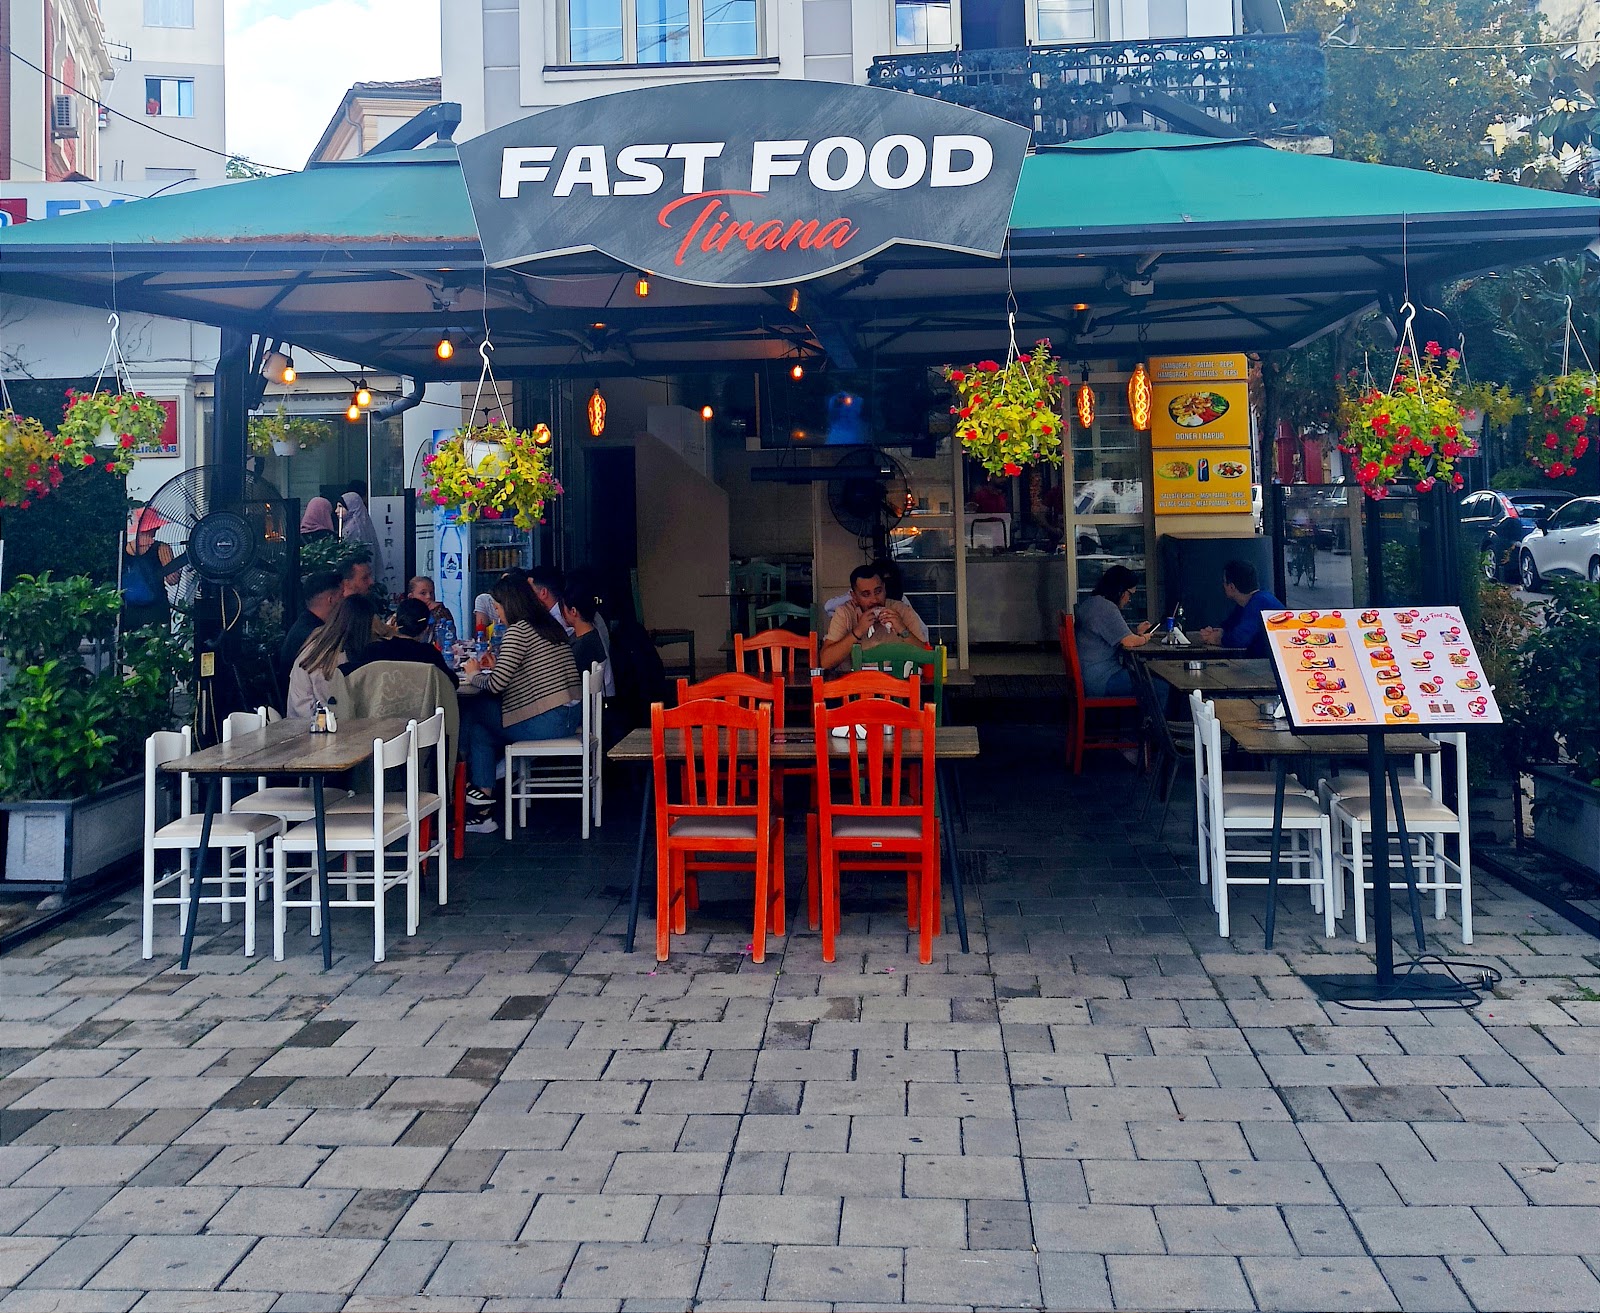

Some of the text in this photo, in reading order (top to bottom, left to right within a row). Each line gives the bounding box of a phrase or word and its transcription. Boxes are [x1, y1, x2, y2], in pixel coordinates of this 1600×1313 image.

[499, 133, 995, 198] FAST FOOD
[657, 189, 861, 267] Tirana
[1160, 362, 1191, 370] HAMBURGER
[1202, 432, 1225, 440] HAPUR
